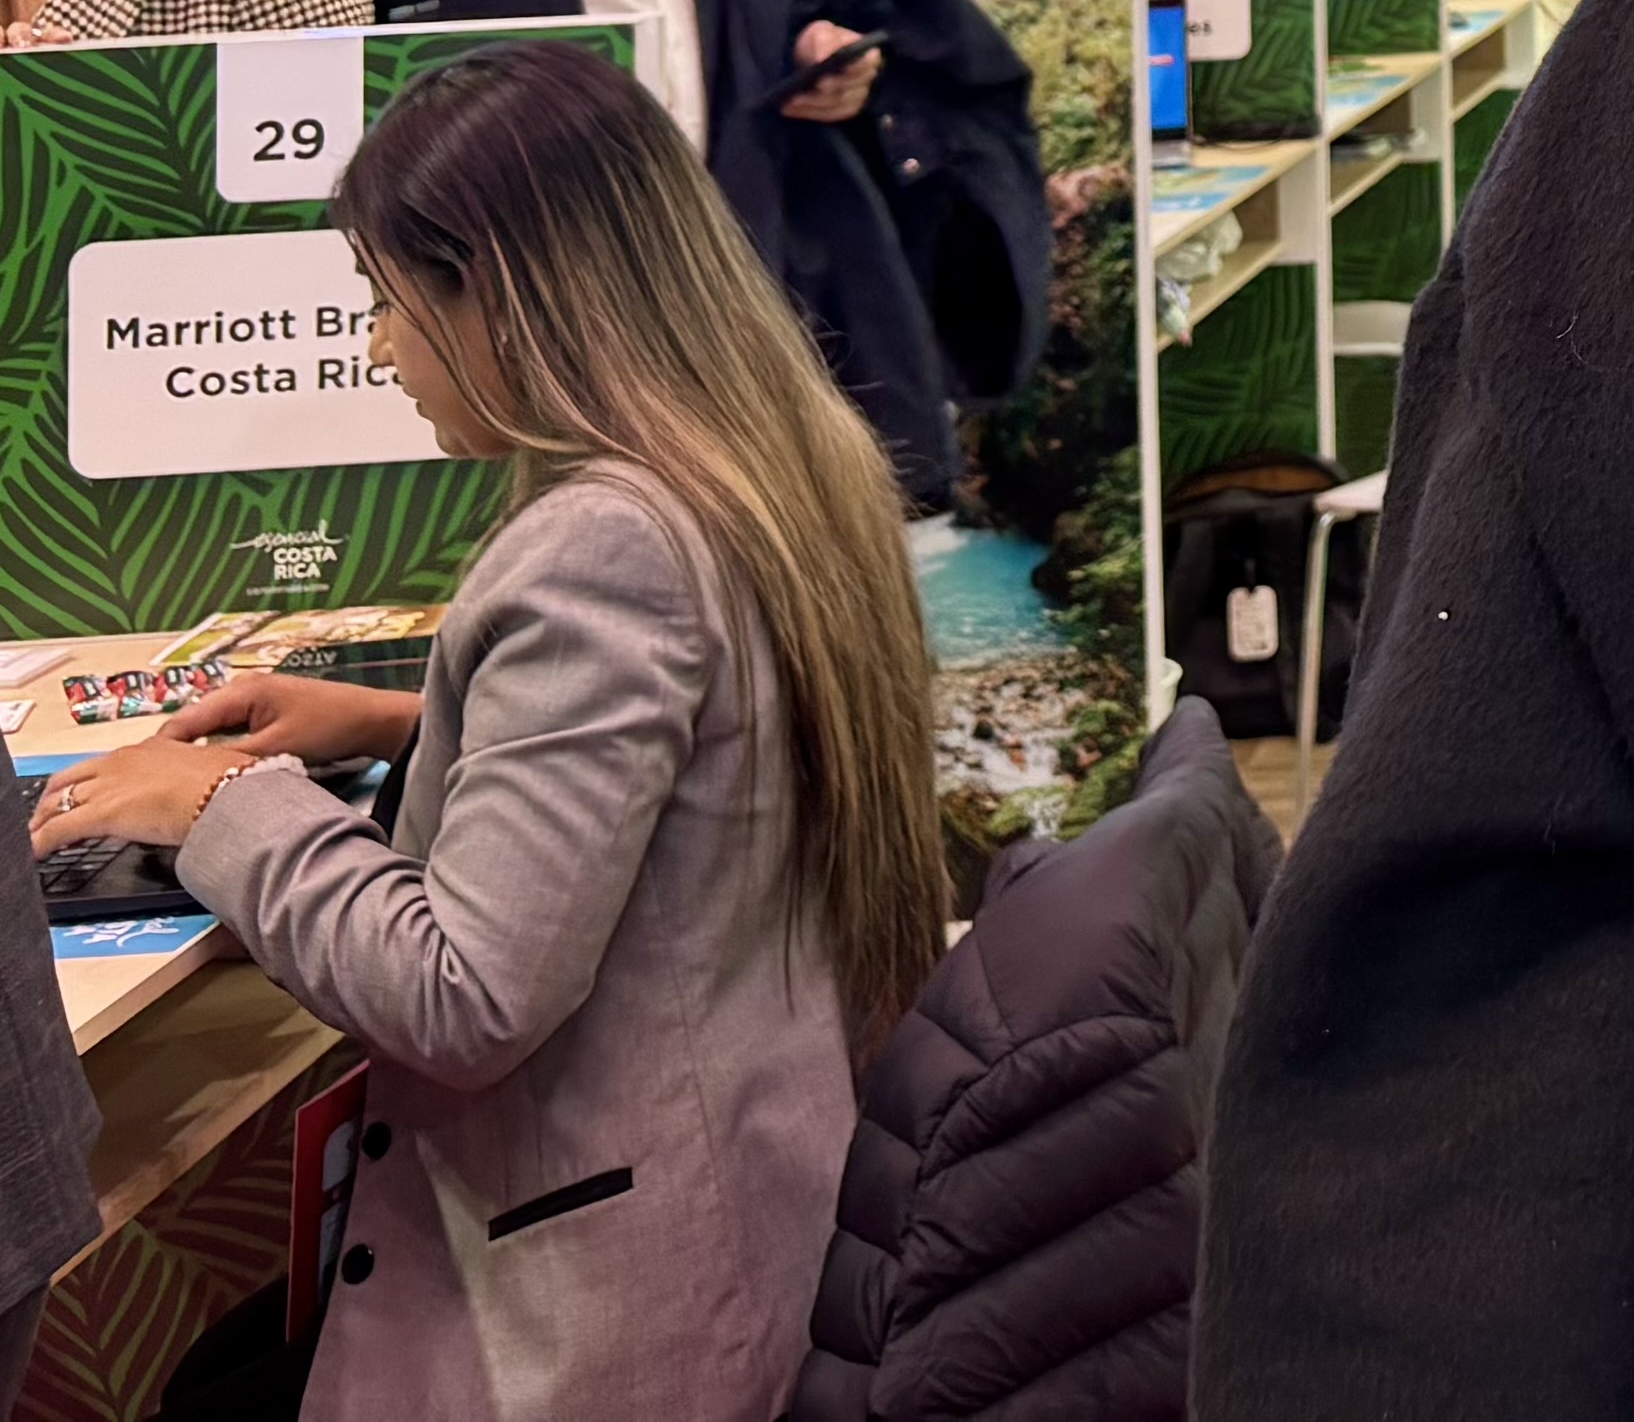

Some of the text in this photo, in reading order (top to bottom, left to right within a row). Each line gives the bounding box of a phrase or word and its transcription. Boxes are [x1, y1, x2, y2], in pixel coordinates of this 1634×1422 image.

[252, 117, 326, 162] 29
[106, 309, 297, 350] Marriott
[165, 362, 297, 399] Costa
[273, 545, 338, 565] COSTA
[273, 562, 322, 581] RICA
